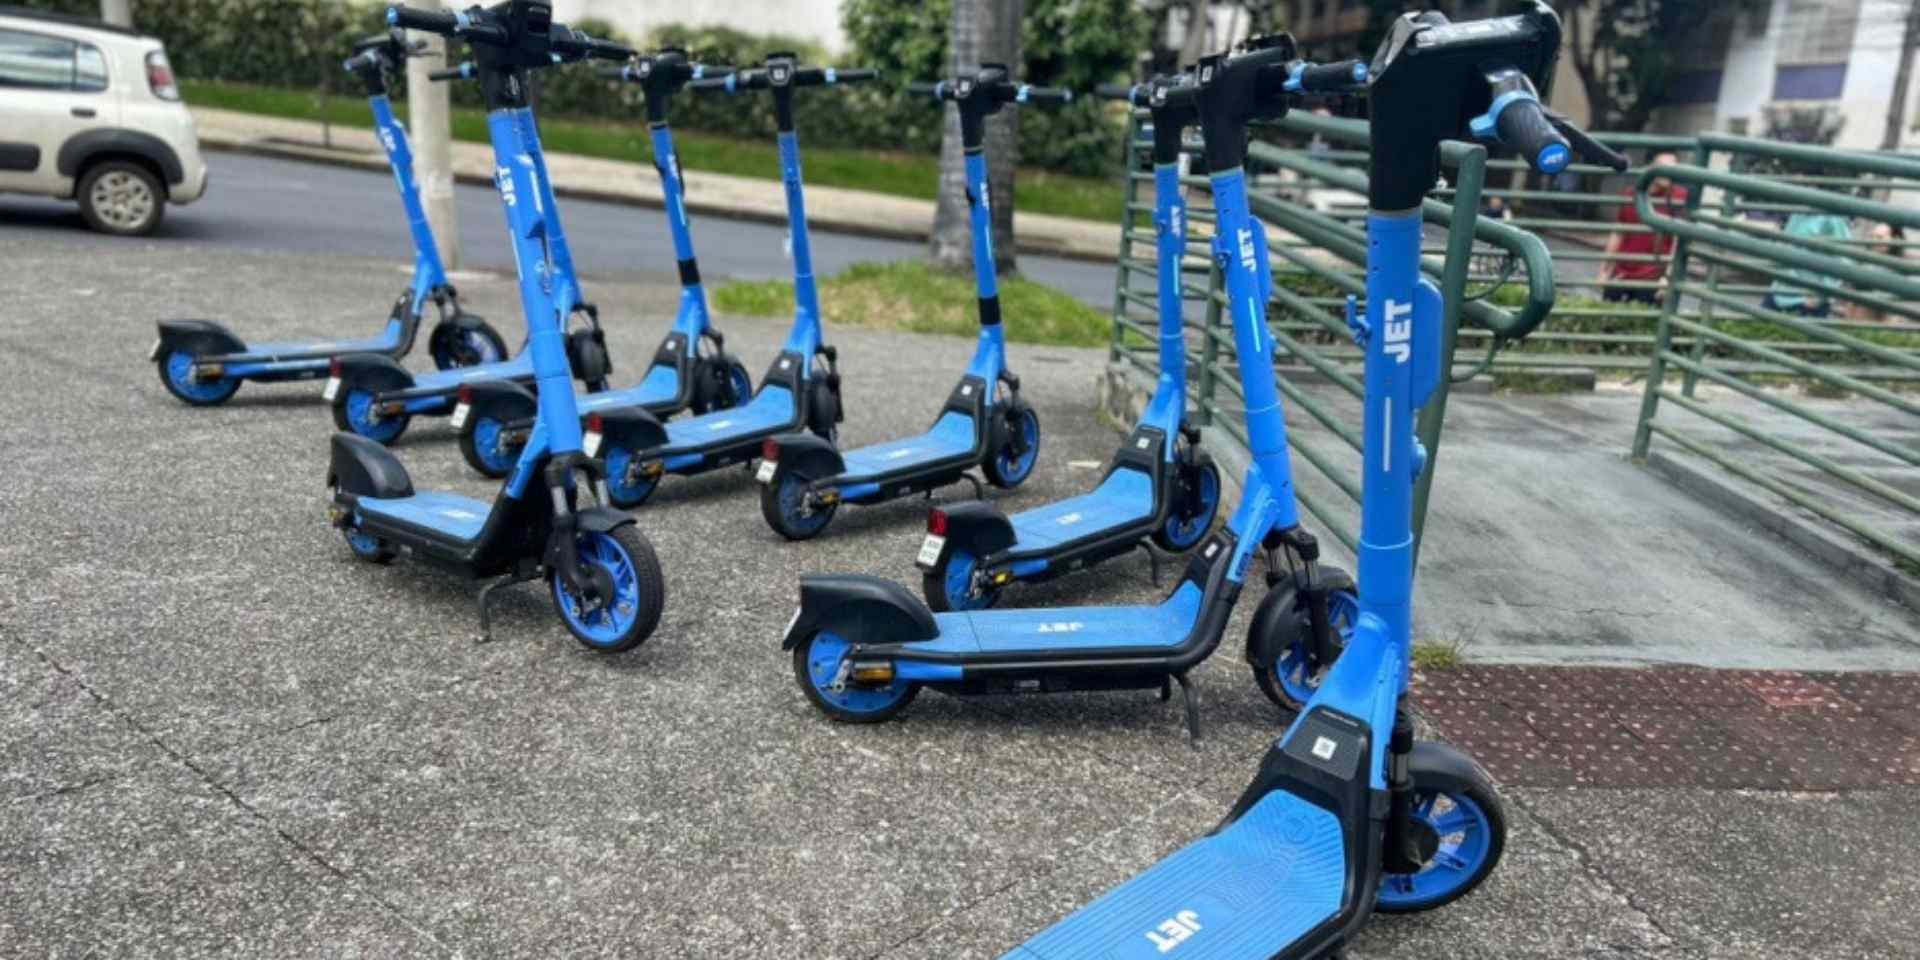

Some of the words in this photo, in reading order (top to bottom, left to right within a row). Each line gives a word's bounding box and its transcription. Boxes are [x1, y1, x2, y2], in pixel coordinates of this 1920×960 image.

[500, 167, 516, 206] JET
[1238, 229, 1256, 271] JET
[1384, 299, 1412, 363] JET
[1037, 622, 1084, 632] JET
[1144, 909, 1202, 952] JET
